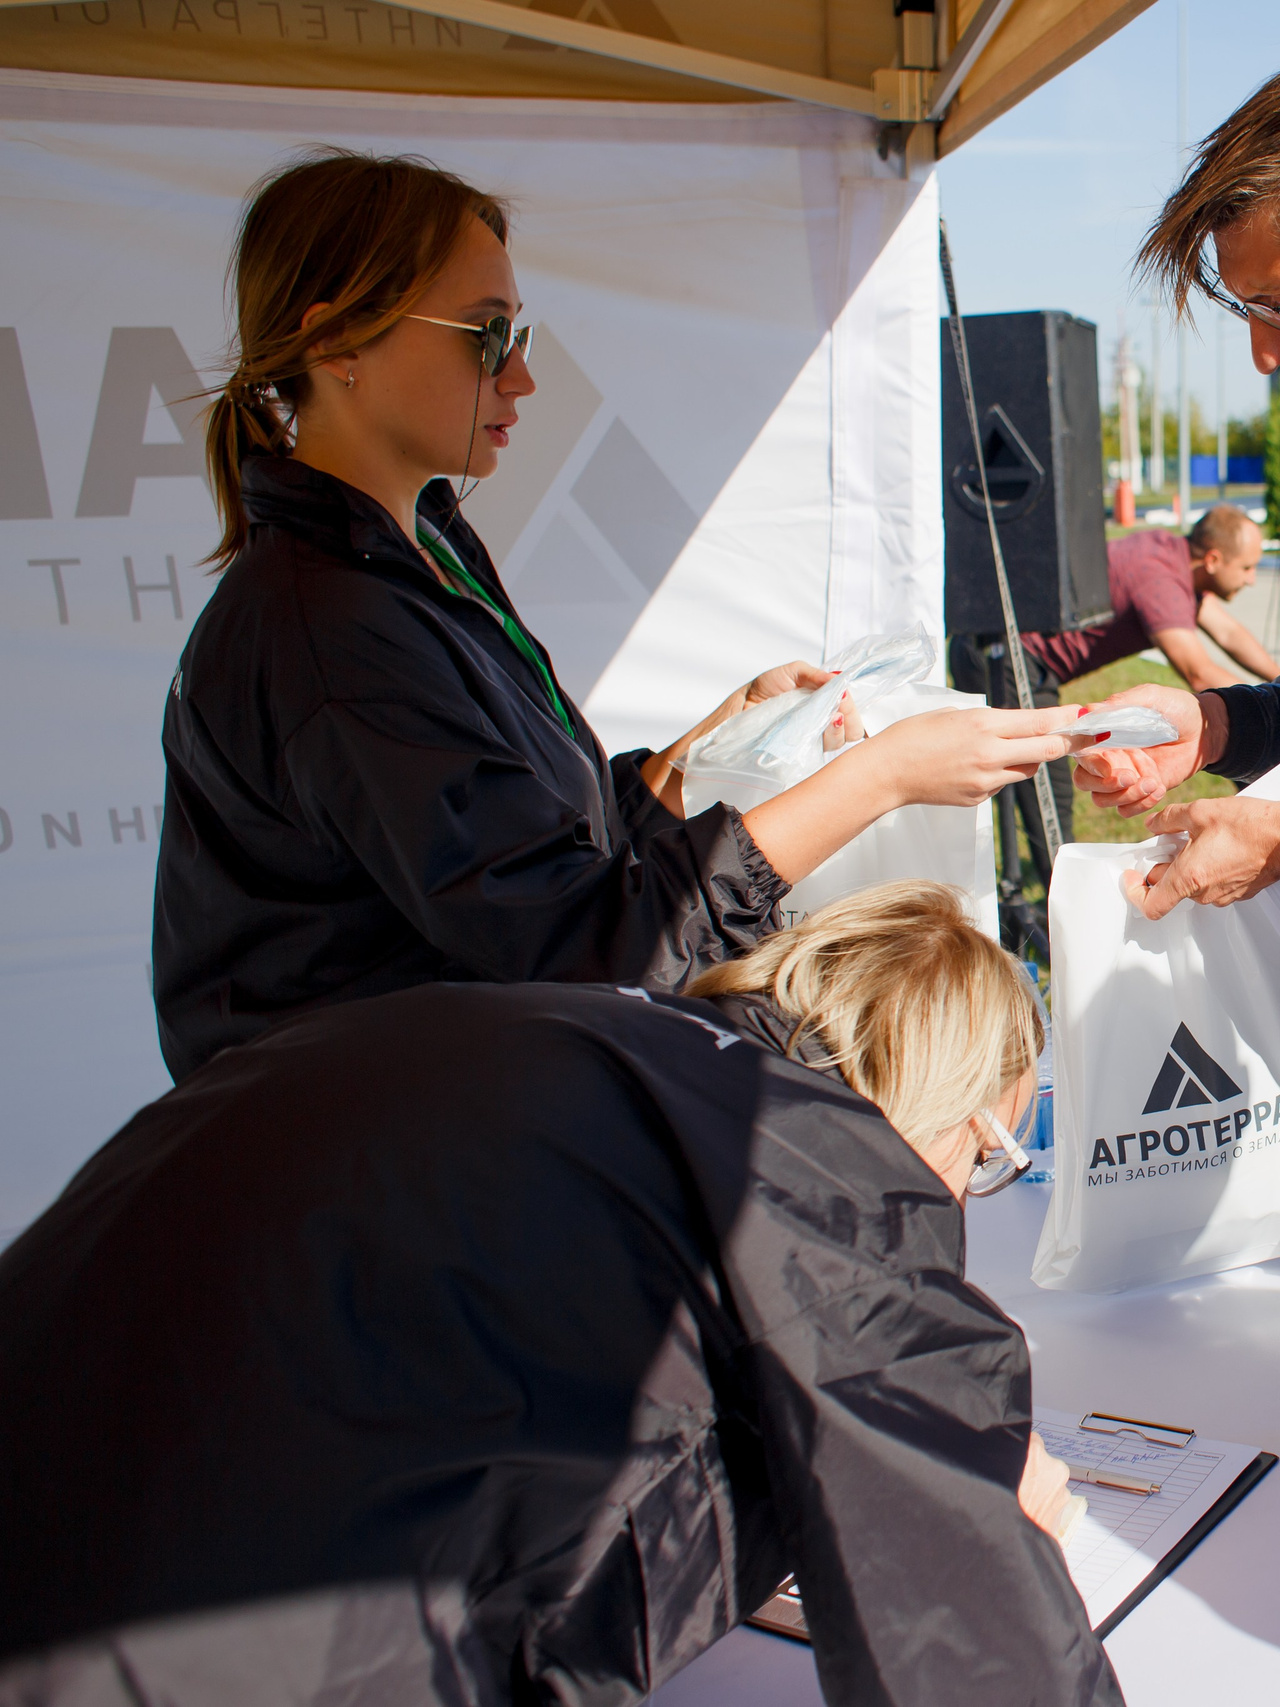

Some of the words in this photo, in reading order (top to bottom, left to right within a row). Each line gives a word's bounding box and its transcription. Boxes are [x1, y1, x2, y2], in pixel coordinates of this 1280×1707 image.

[1088, 1172, 1118, 1187] МЫ
[1125, 1151, 1228, 1182] ЗАБОТИМСЯ
[1232, 1145, 1243, 1159] О
